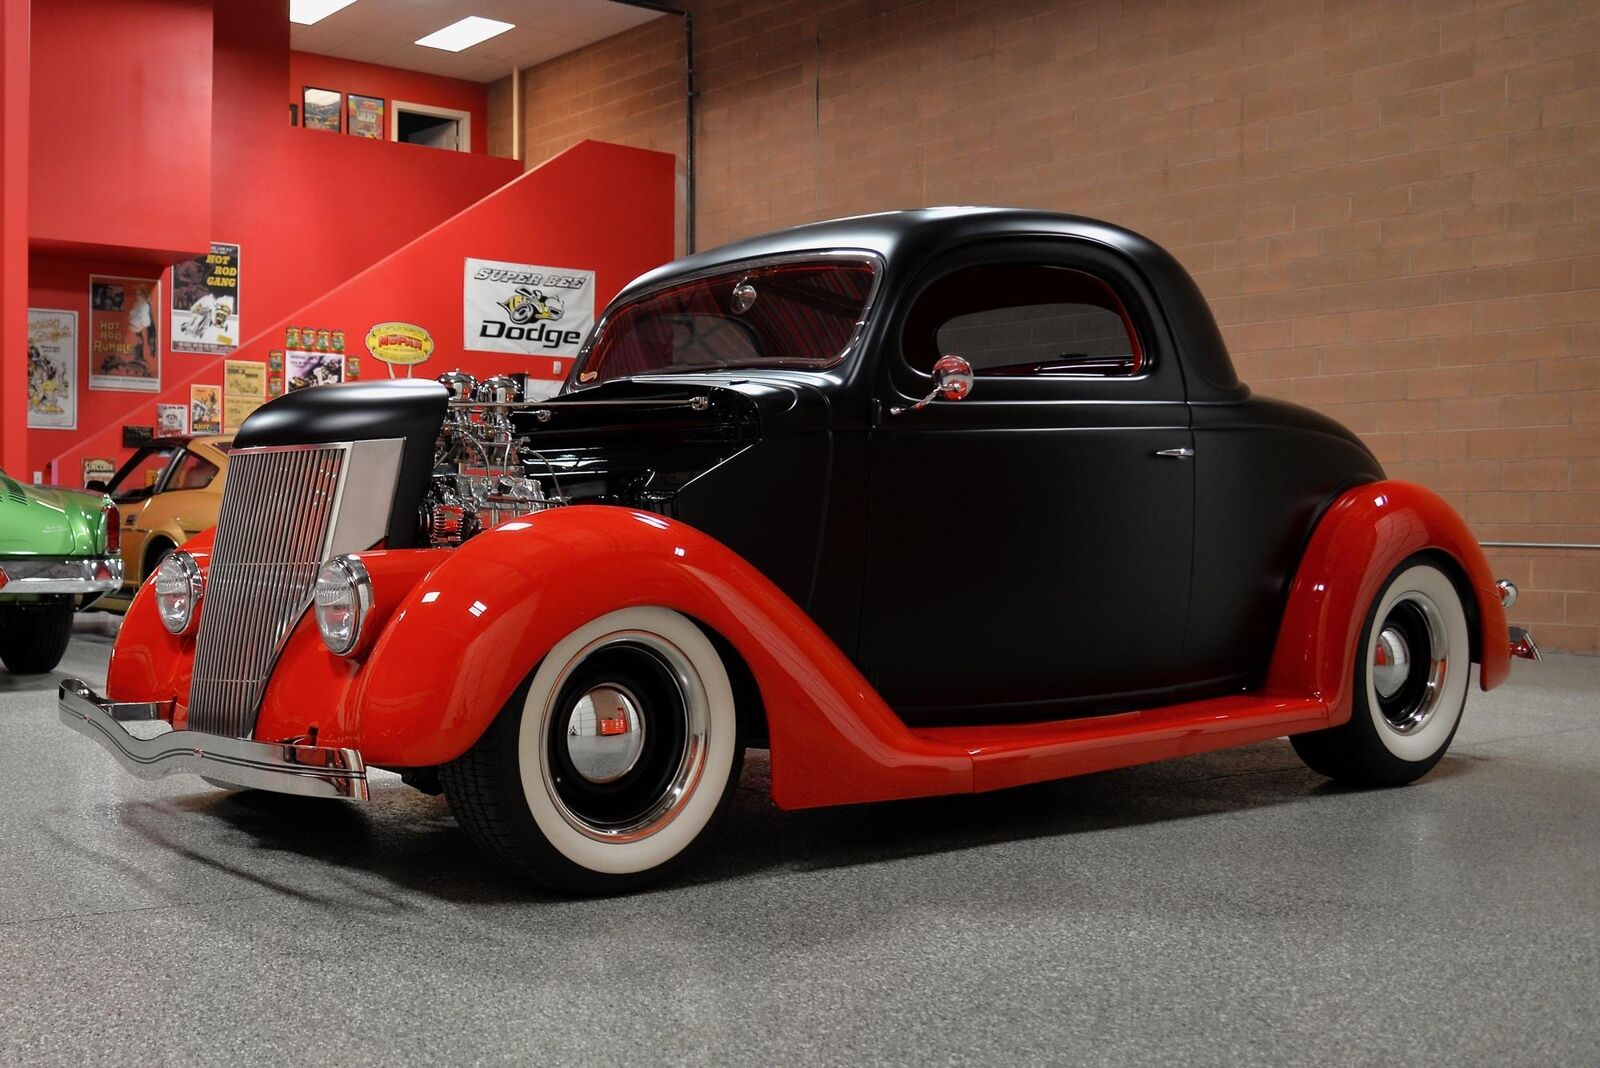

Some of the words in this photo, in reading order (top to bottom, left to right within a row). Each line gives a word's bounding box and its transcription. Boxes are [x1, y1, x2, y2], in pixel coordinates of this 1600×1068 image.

[206, 255, 230, 265] HOT
[214, 266, 236, 276] ROD
[207, 277, 236, 287] GANG
[474, 268, 543, 286] SUPER
[543, 275, 587, 289] BEE
[100, 322, 121, 330] HOT
[101, 332, 122, 340] ROD
[480, 320, 581, 349] Dodge
